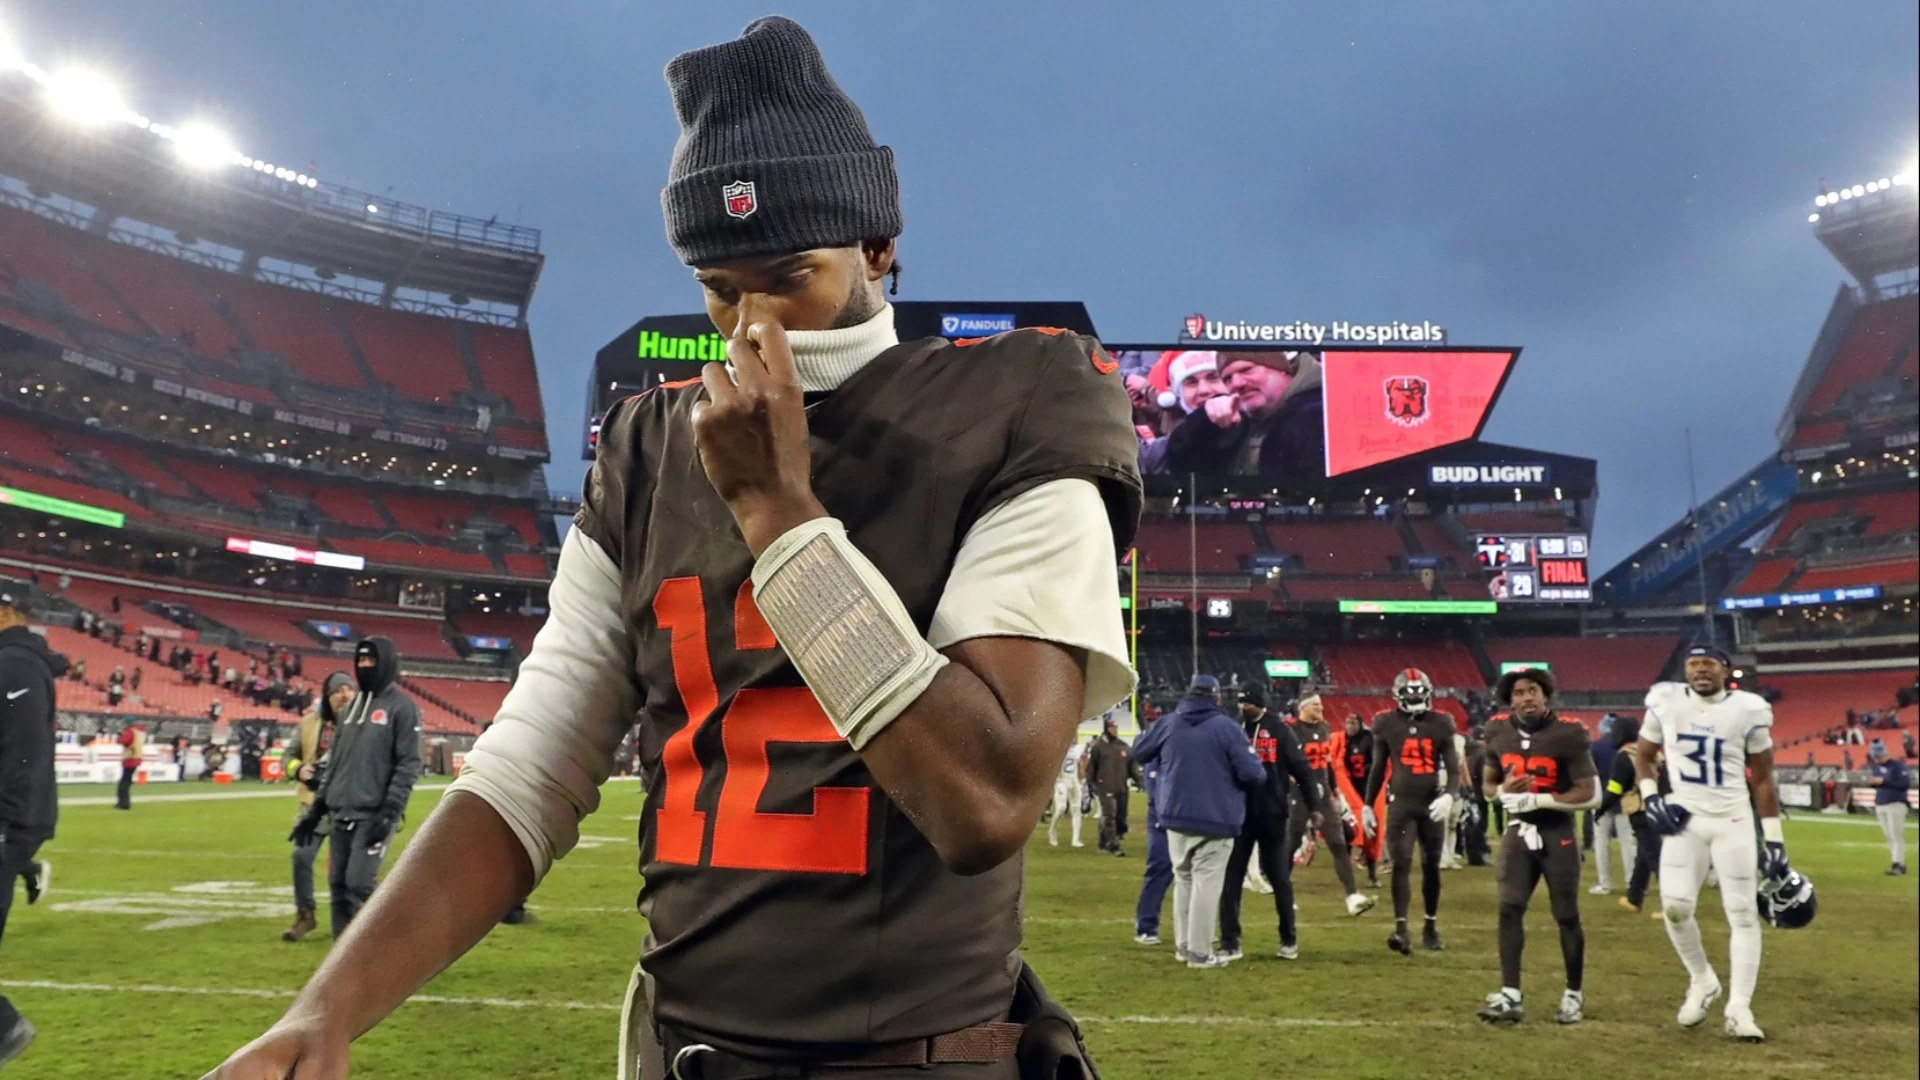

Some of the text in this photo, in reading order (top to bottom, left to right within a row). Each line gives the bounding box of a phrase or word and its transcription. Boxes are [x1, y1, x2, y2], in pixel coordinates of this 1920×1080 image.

[961, 319, 1015, 331] FANDUEL
[1205, 320, 1443, 346] University Hospitals
[1432, 465, 1545, 483] BUD LIGHT
[1511, 542, 1526, 563] 31
[1542, 560, 1586, 584] FINAL
[652, 575, 871, 876] 12
[1400, 737, 1435, 775] 41
[1676, 732, 1725, 787] 31
